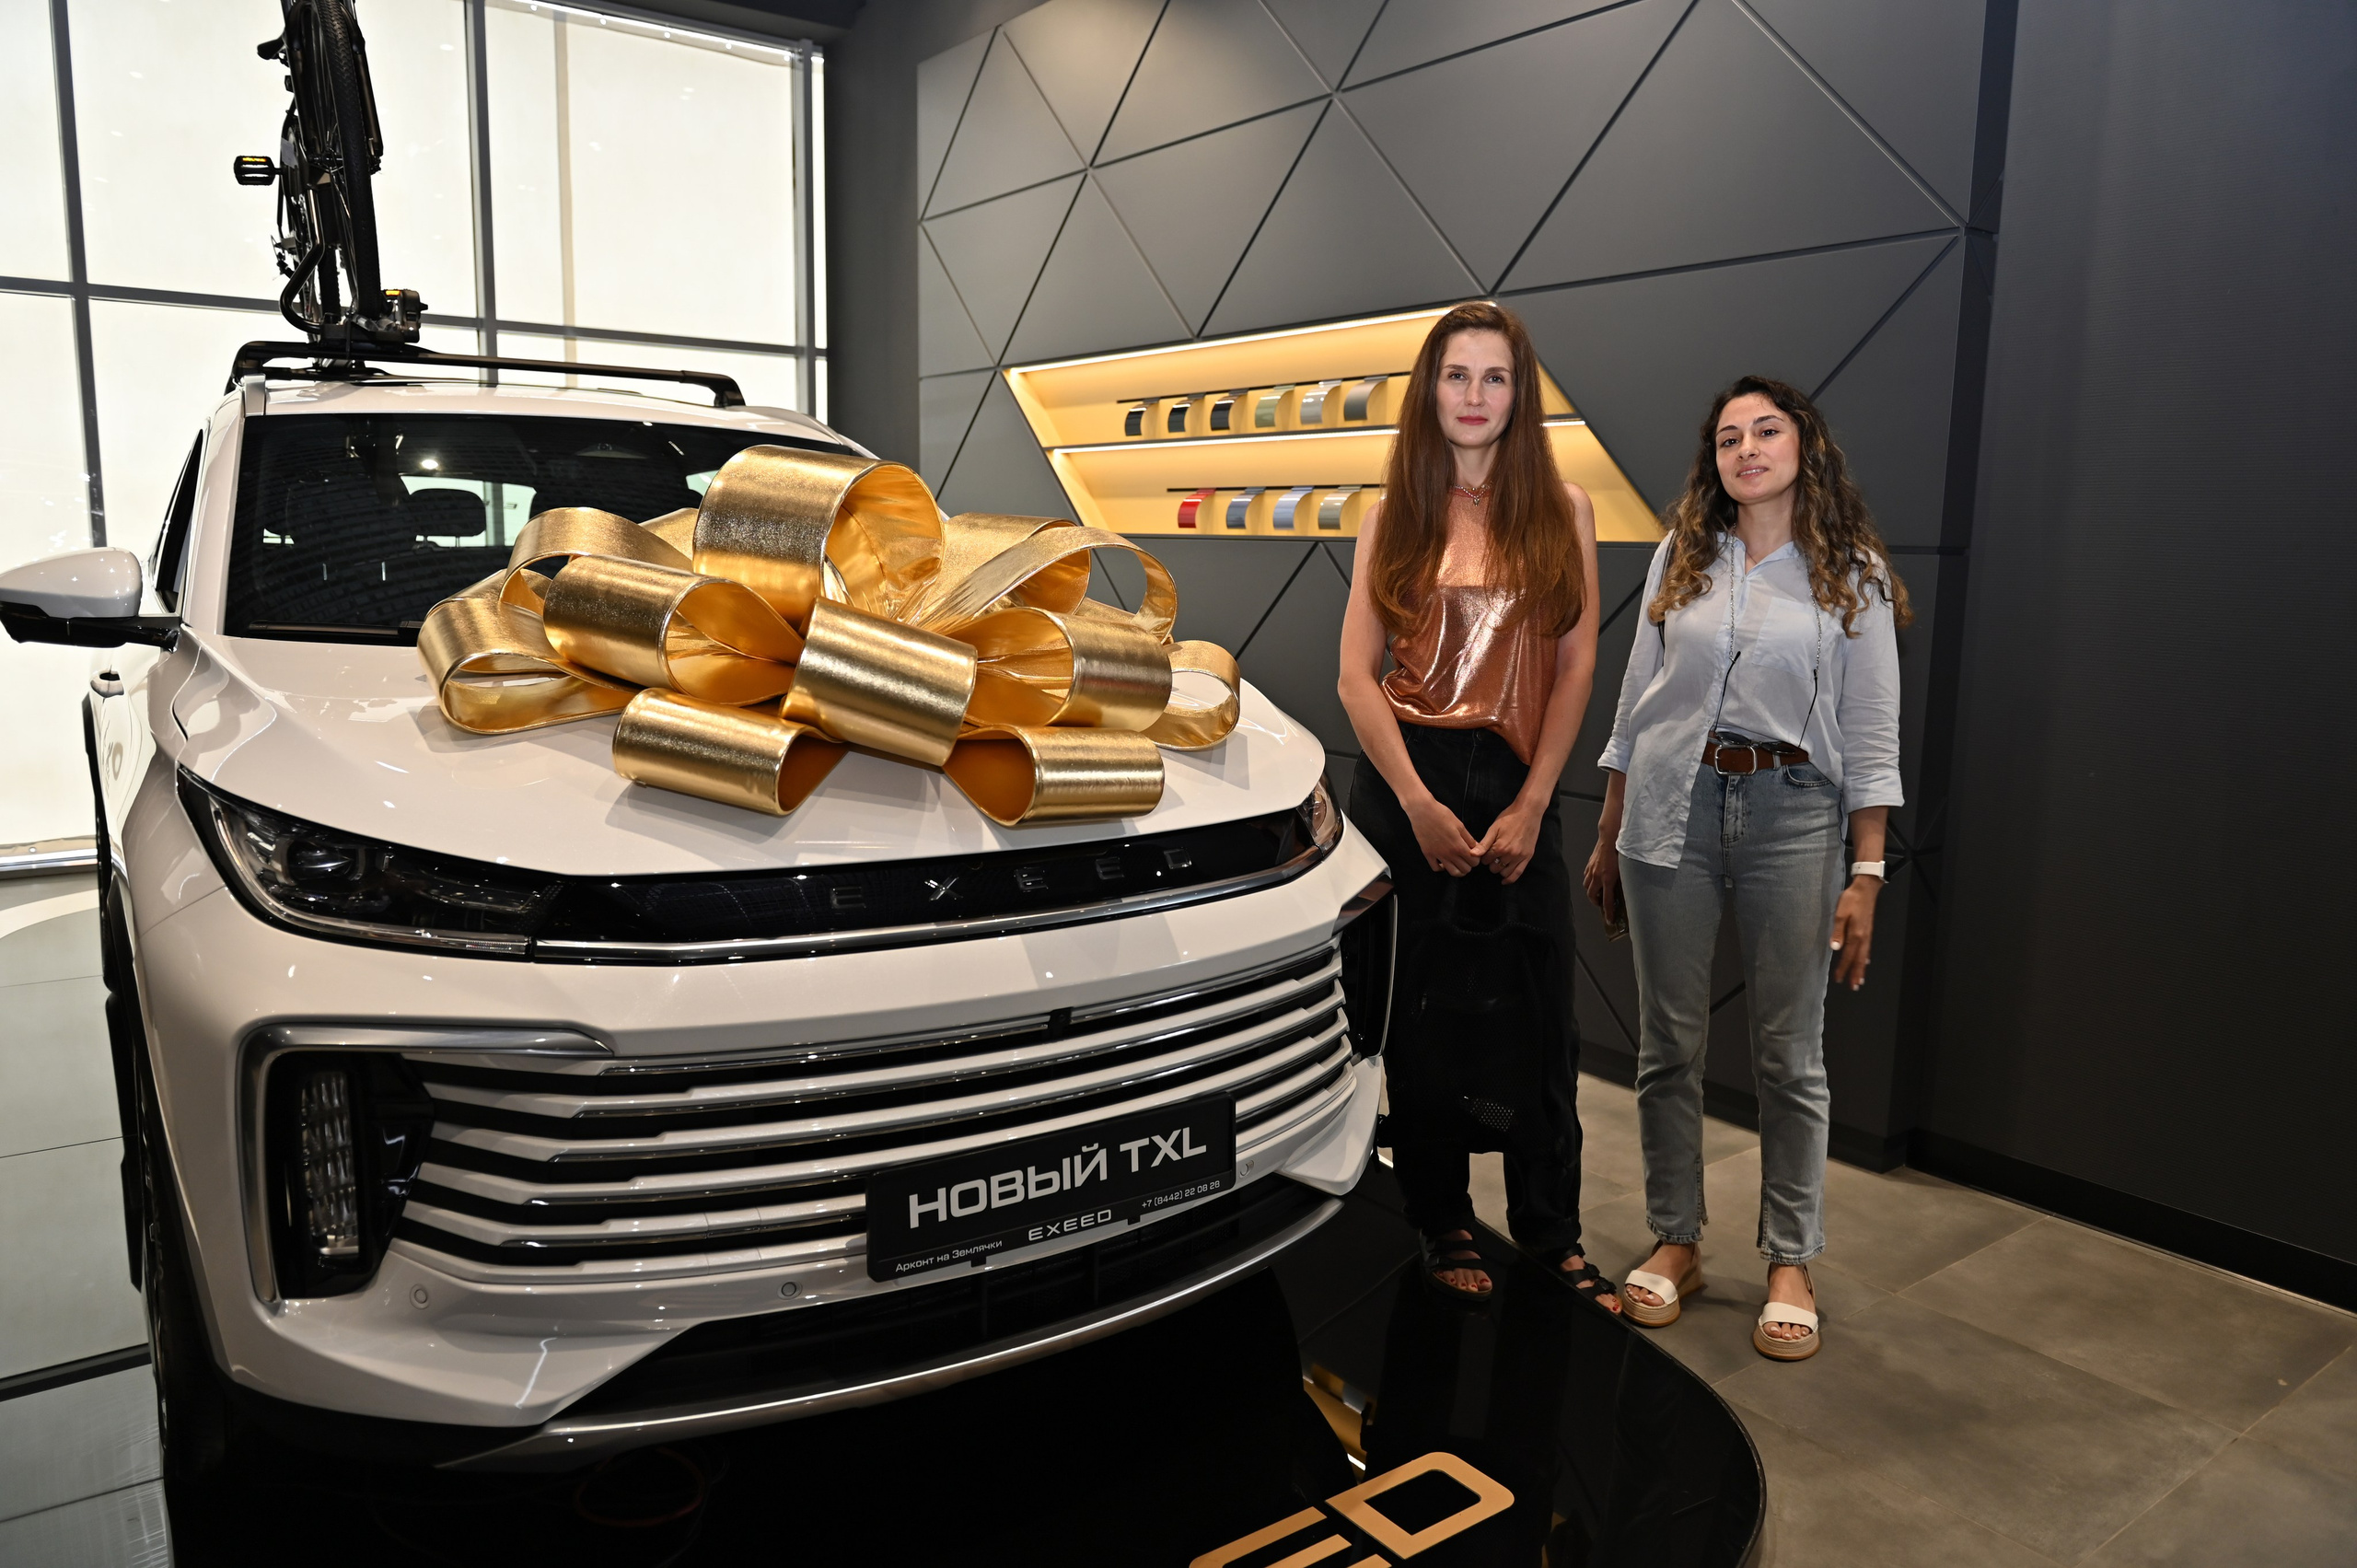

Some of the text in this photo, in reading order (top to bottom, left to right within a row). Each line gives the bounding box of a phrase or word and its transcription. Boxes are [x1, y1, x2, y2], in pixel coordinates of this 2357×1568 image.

[830, 846, 1192, 910] EXEED
[910, 1126, 1207, 1229] НОВЫЙ TXL
[1142, 1179, 1221, 1209] +7 (8442) 22 08 28
[1028, 1209, 1112, 1241] EXEED
[895, 1240, 1003, 1272] Арконт на Землячки
